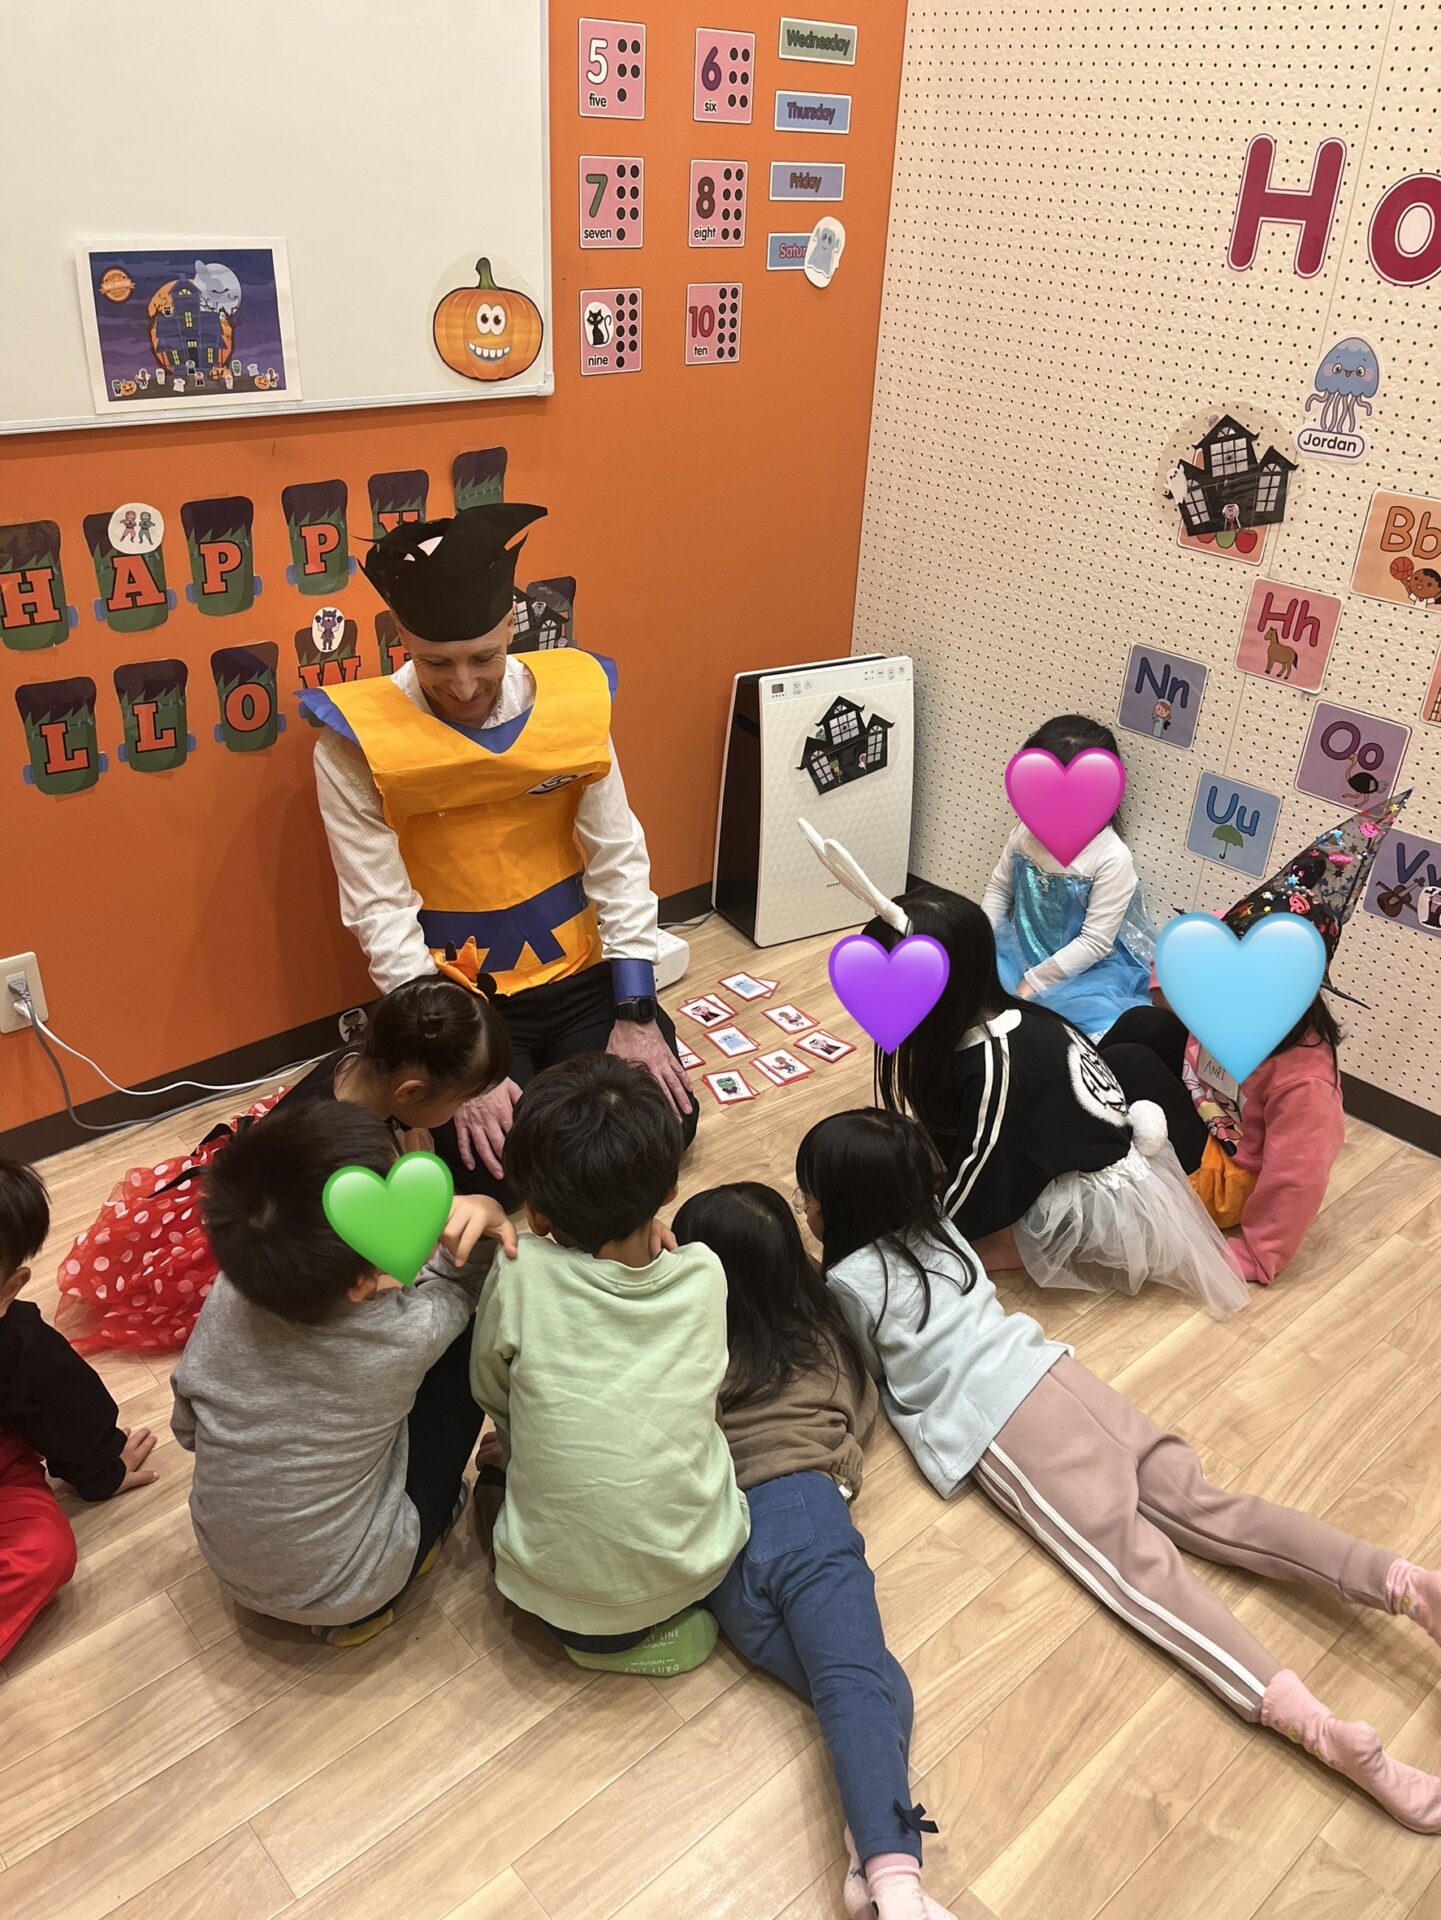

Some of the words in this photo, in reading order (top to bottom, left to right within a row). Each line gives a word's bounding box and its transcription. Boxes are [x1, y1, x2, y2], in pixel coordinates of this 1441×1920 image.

[786, 28, 850, 56] Wednesday
[586, 38, 608, 85] 5
[701, 46, 722, 91] 6
[588, 92, 607, 109] five
[704, 99, 717, 112] six
[787, 102, 836, 125] Thursday
[586, 173, 608, 218] 7
[696, 176, 715, 219] 8
[789, 172, 822, 193] Friday
[583, 228, 612, 240] seven
[693, 226, 716, 241] eight
[689, 304, 715, 338] 10
[588, 355, 608, 367] nine
[694, 345, 708, 356] ten
[1303, 435, 1358, 454] Jordan
[1380, 505, 1441, 559] Bb
[1257, 591, 1321, 647] Hh
[1135, 656, 1190, 708] Nn
[1320, 720, 1385, 771] Oo
[1206, 785, 1260, 837] Uu
